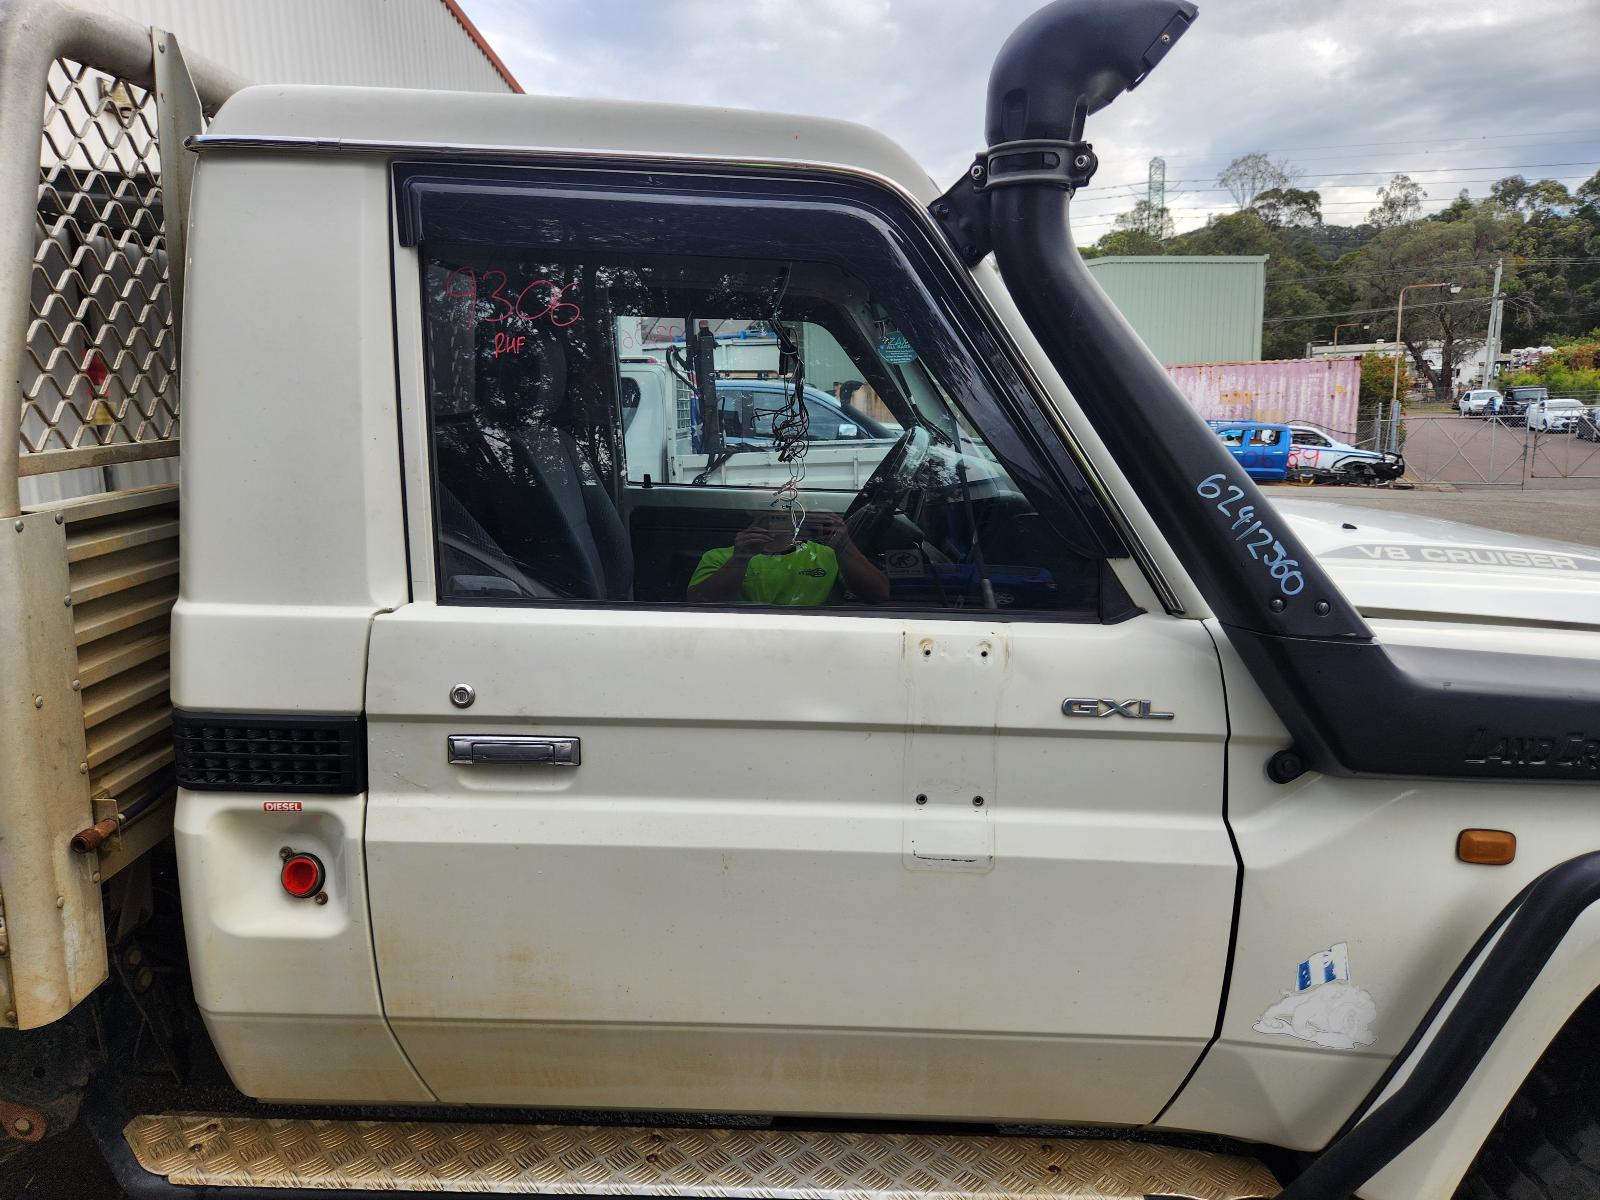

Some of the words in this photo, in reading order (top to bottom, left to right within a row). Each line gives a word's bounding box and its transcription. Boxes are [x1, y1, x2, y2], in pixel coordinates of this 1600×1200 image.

[446, 266, 580, 330] 9306
[1357, 545, 1410, 560] V8
[1421, 546, 1578, 569] CRUISER
[1061, 697, 1174, 720] GXL
[265, 802, 301, 811] DIESEL
